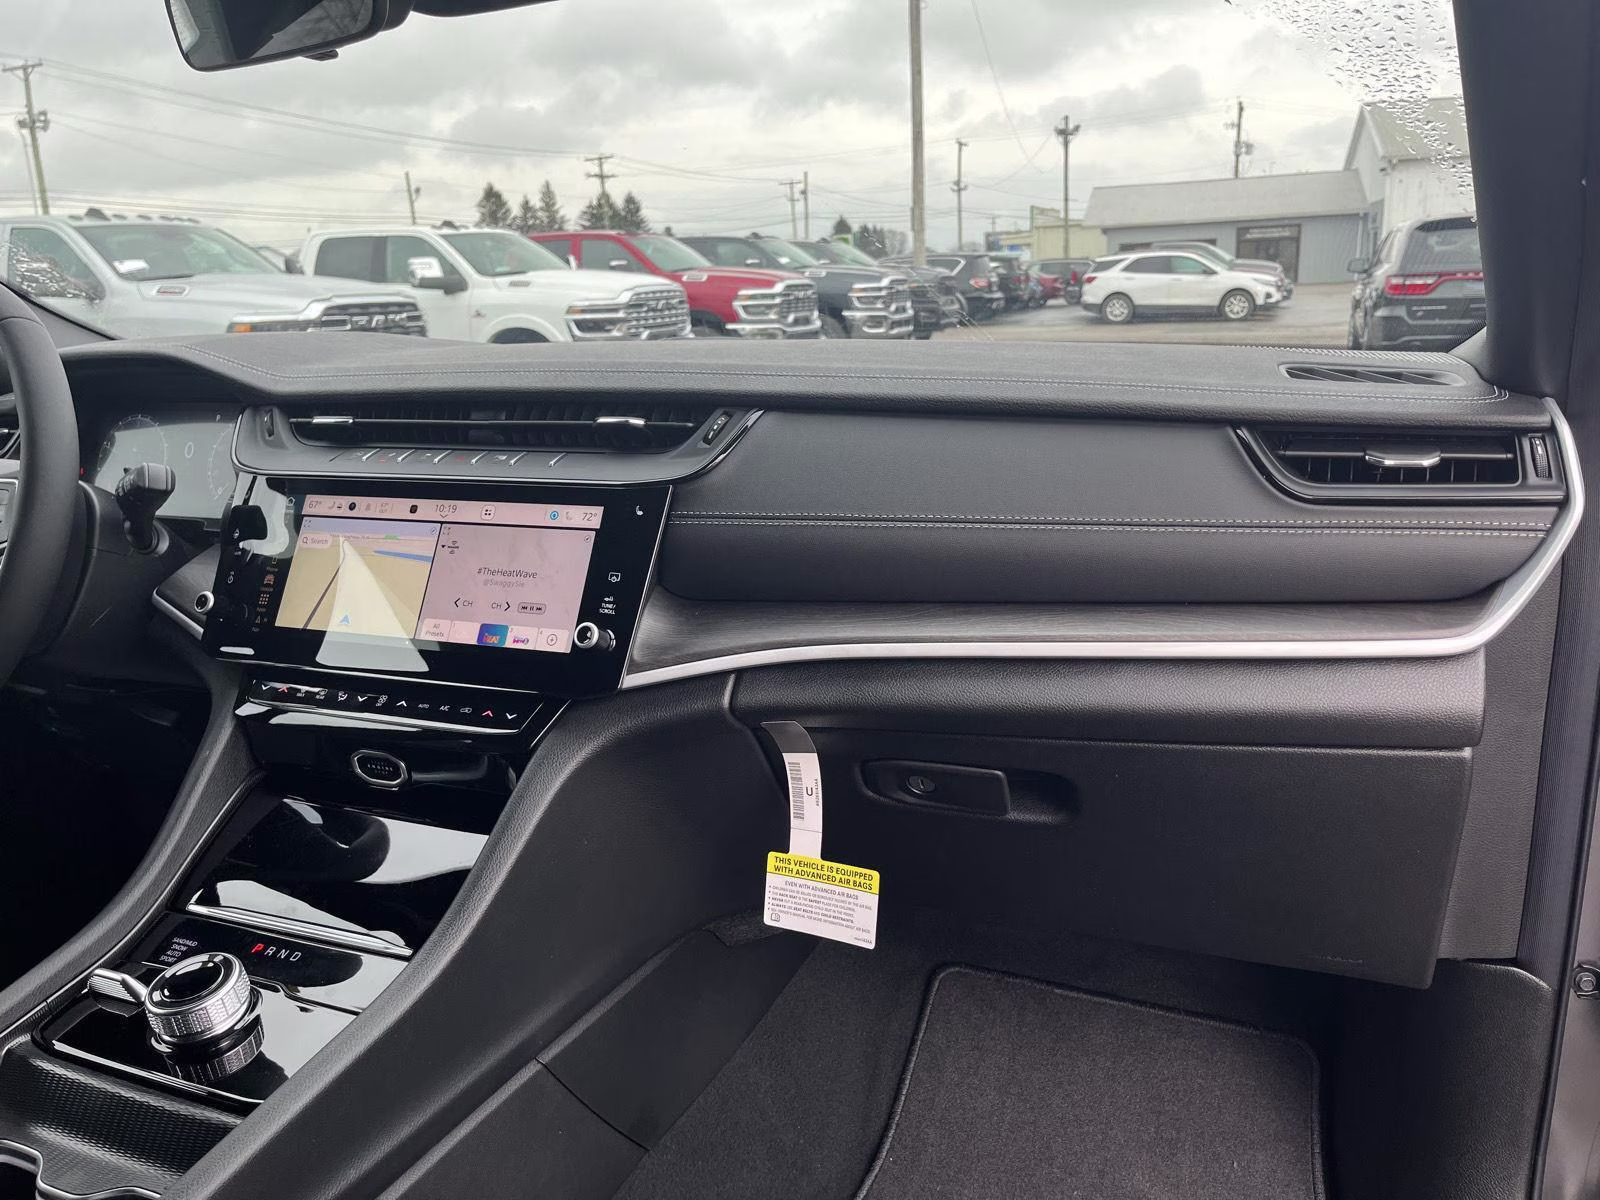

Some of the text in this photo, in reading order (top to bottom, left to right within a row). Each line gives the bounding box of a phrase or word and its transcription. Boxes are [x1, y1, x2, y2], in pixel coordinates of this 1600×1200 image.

[435, 504, 458, 513] 10:19
[582, 512, 598, 522] 72°
[477, 567, 538, 579] #TheHeatWave
[462, 600, 473, 608] CH
[491, 602, 502, 610] CH
[774, 856, 874, 882] THIS VEHICLE IS EQUIPPED
[773, 865, 873, 891] WITH ADVANCED AIR BAGS
[785, 880, 797, 888] EVEN
[811, 885, 837, 896] ADVANCED
[837, 890, 846, 898] AIR
[846, 892, 859, 901] BAGS
[170, 943, 188, 952] SNOW
[251, 943, 302, 961] P R N D
[166, 949, 182, 957] AUTO
[159, 955, 177, 963] SPORT
